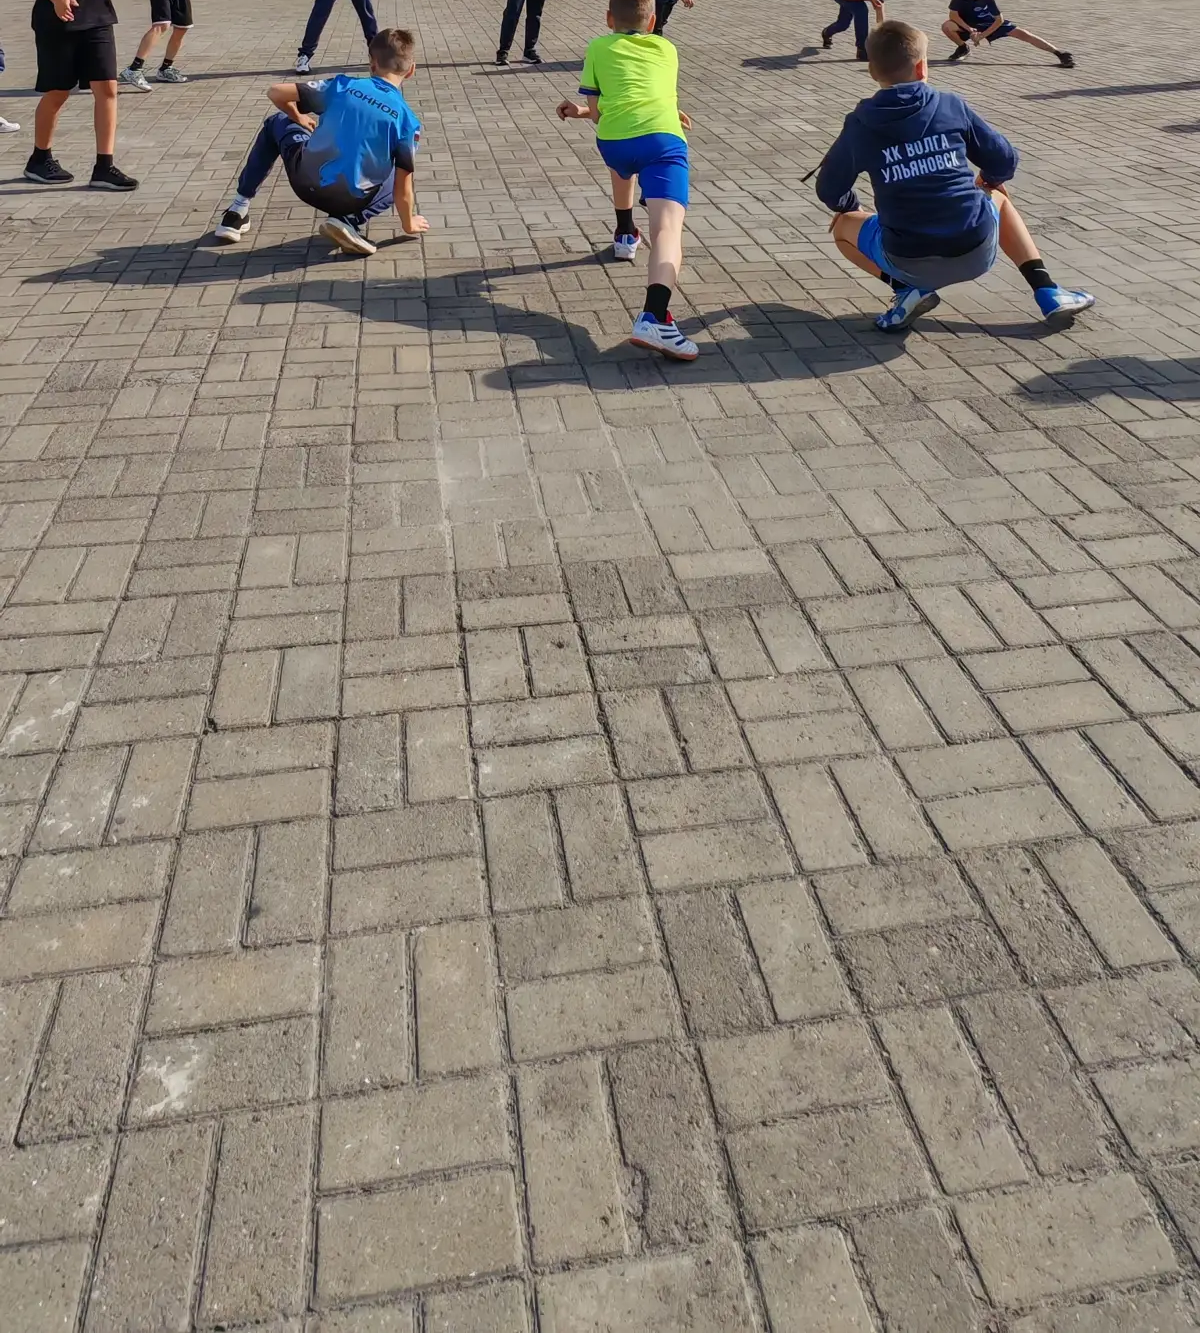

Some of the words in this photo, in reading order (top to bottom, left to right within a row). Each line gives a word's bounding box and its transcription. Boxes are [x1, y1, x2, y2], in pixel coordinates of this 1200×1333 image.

[881, 145, 903, 164] ХК
[905, 133, 949, 157] ВОЛГА
[881, 151, 960, 183] УЛЬЯНОВСК
